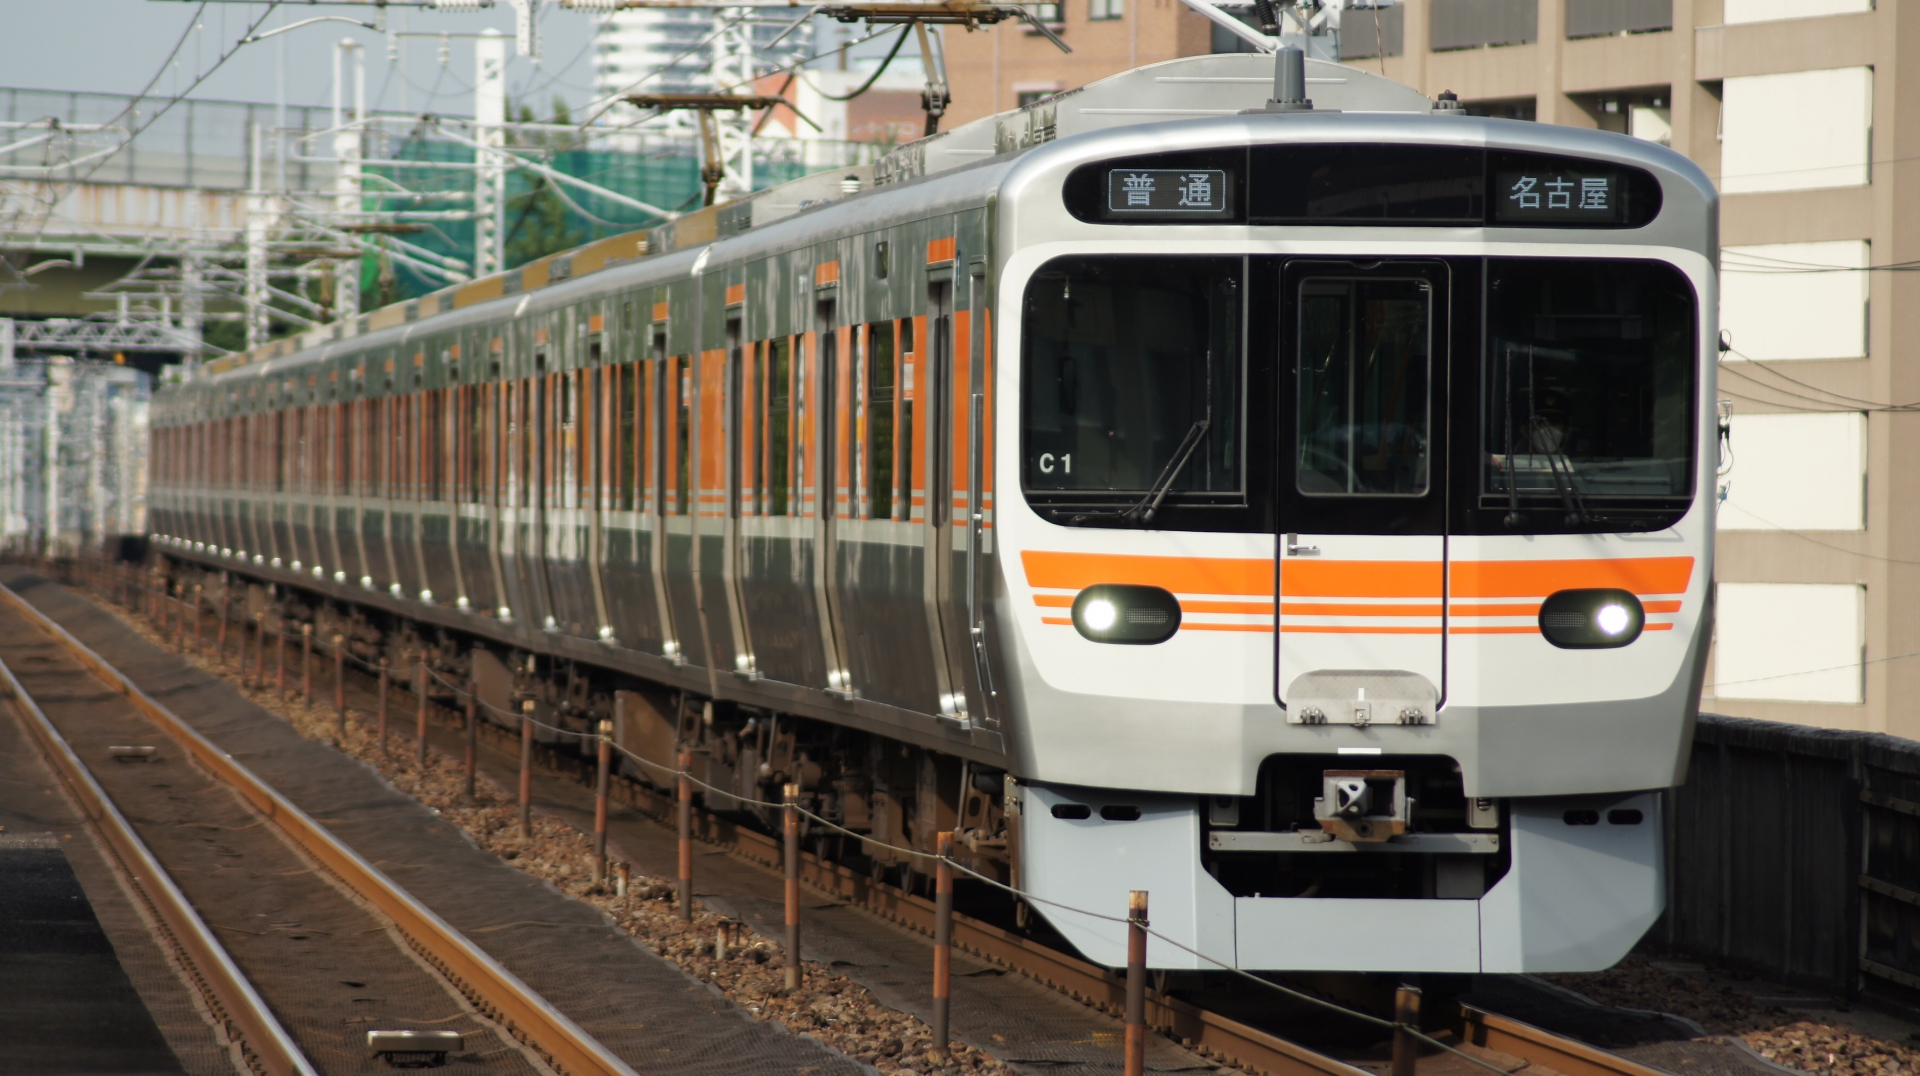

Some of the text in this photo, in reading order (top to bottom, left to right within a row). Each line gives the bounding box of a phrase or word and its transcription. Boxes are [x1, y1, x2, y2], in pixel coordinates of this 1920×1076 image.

[1122, 173, 1212, 206] 普通
[1509, 175, 1609, 209] 名古屋
[1039, 452, 1071, 473] C1
